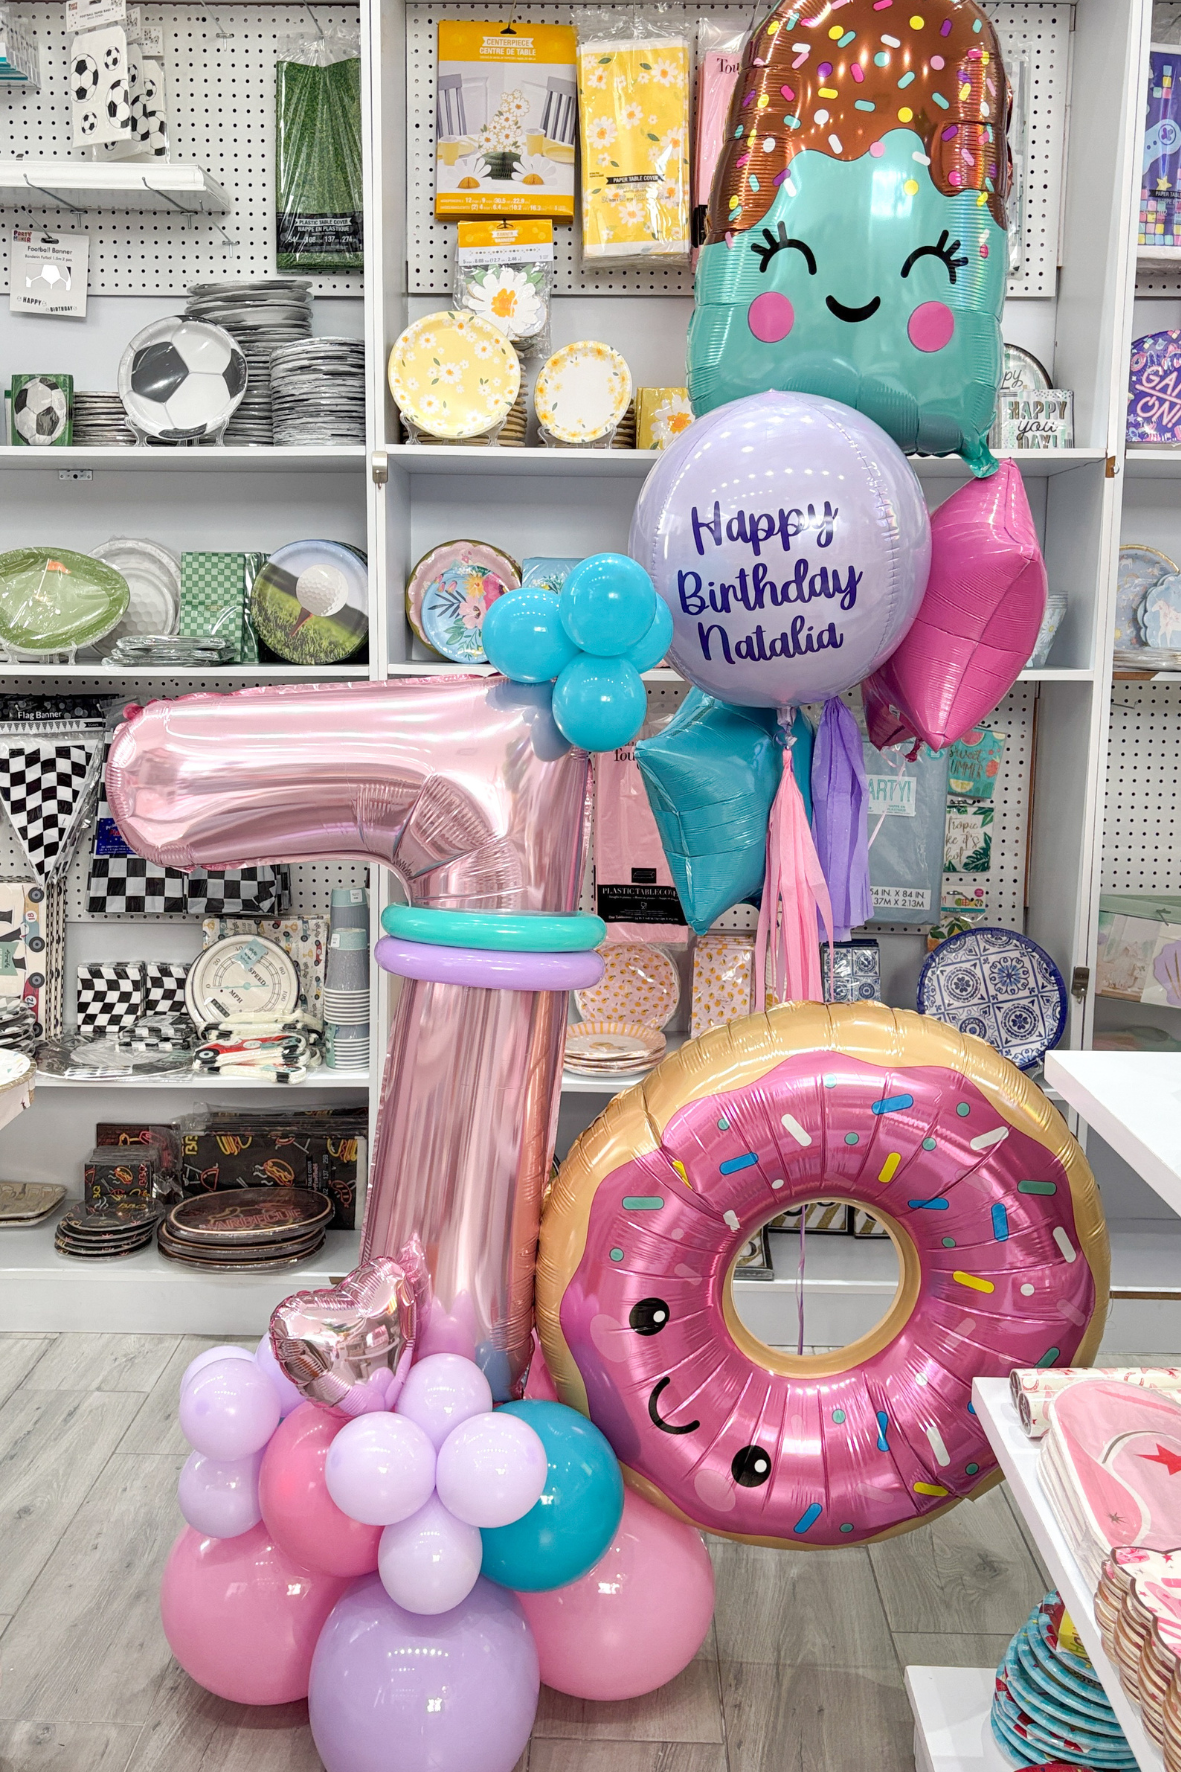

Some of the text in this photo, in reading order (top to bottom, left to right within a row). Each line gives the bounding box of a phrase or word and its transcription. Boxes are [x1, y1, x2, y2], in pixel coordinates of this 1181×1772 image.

[486, 38, 530, 46] CENTERPIECE
[480, 47, 504, 55] CENTRE
[516, 48, 536, 56] TABLE
[22, 296, 42, 306] HAPPY
[1008, 400, 1068, 420] HAPPY
[691, 500, 839, 556] Happy
[677, 558, 864, 616] Birthday
[697, 615, 844, 665] Natalia
[18, 710, 62, 720] Flag Banner
[614, 747, 636, 762] Tou
[950, 759, 983, 780] UMMER
[868, 778, 912, 802] ARTY!
[902, 890, 913, 898] 84
[894, 898, 900, 906] X
[902, 899, 924, 908] 2.13M
[27, 912, 34, 920] 18
[248, 967, 266, 986] SPEED
[279, 966, 286, 976] 80
[229, 990, 244, 1004] MPH
